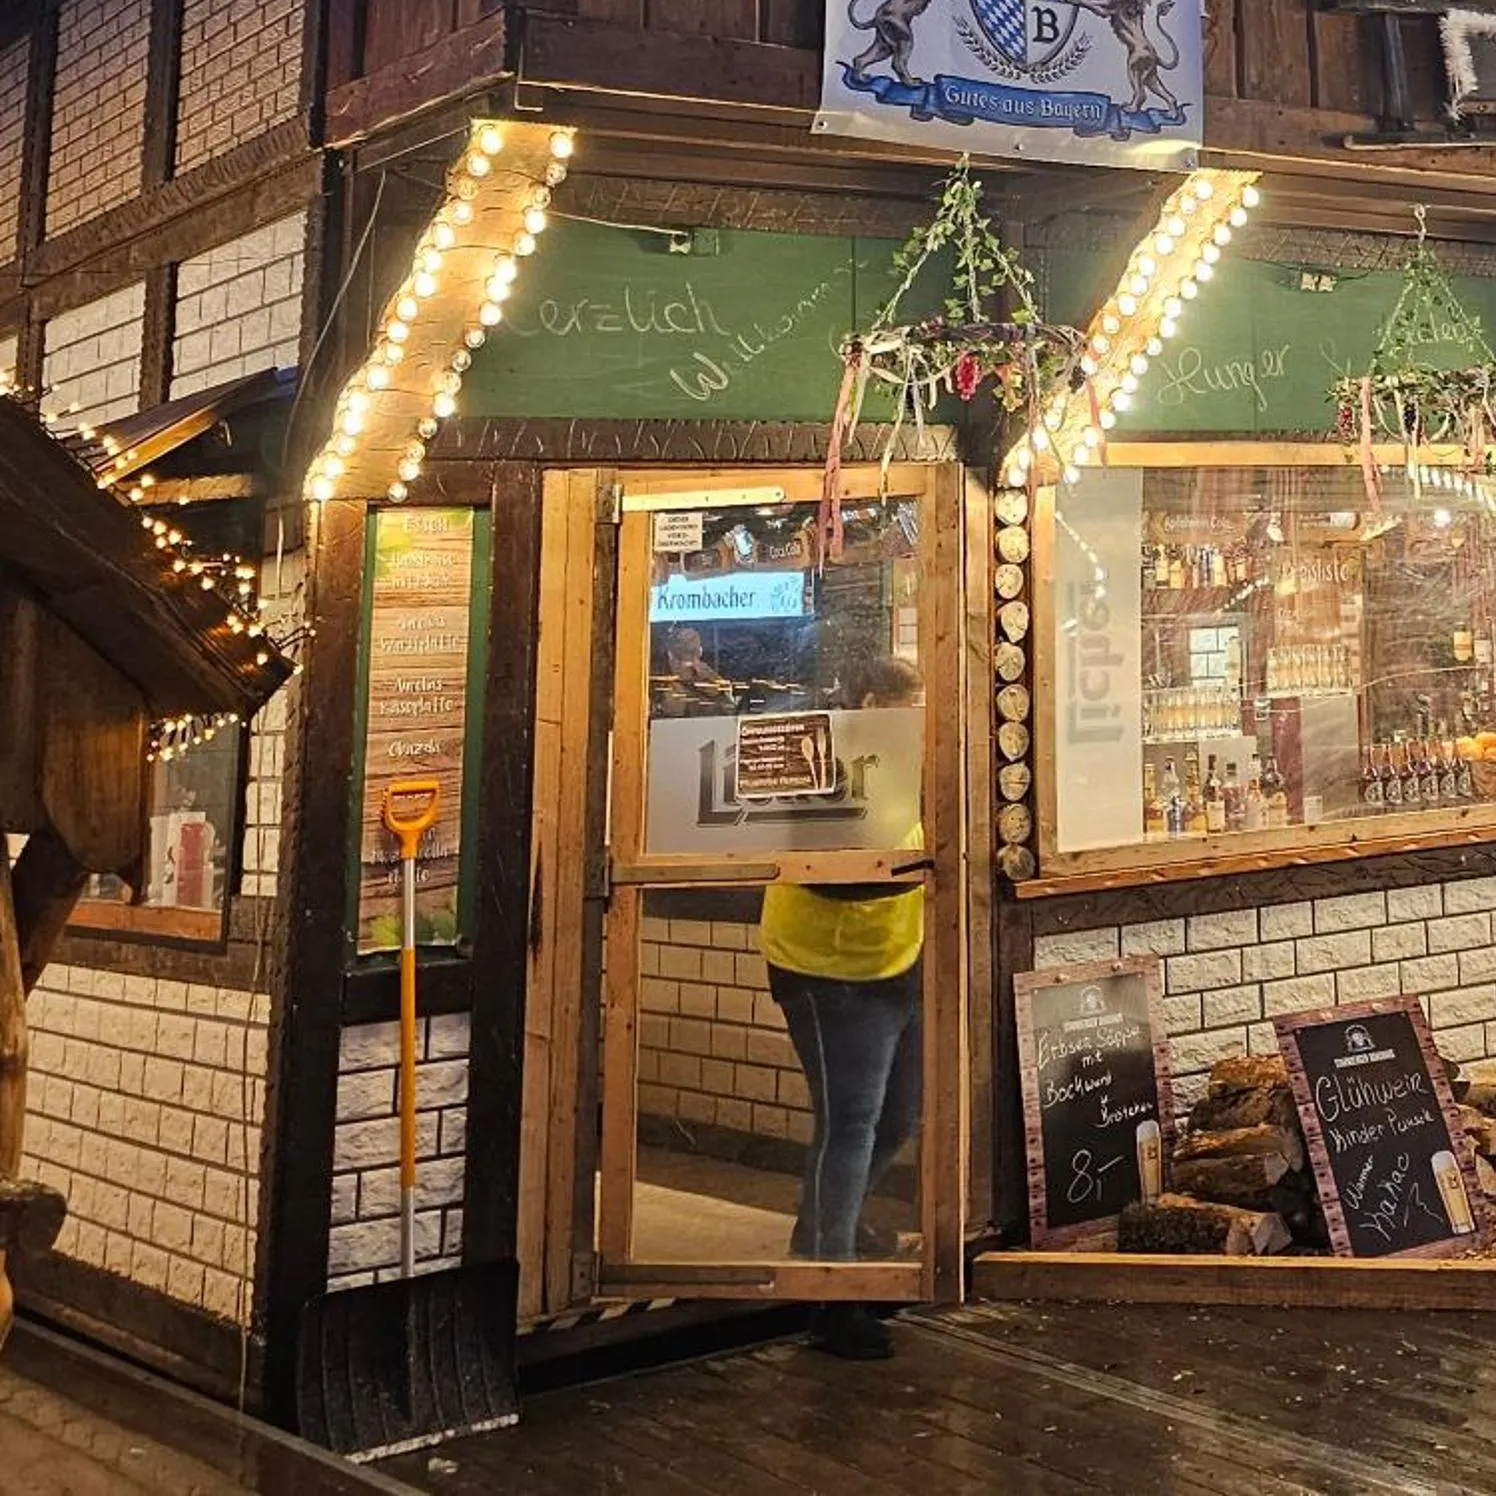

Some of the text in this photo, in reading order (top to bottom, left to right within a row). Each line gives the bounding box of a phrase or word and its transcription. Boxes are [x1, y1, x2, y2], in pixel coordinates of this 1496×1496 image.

[1032, 6, 1059, 44] B
[945, 86, 999, 112] Gutes
[1039, 97, 1101, 120] Bayern
[504, 277, 731, 338] erzlich
[1157, 343, 1290, 412] Hunger
[657, 584, 756, 611] Krombacher
[1315, 1071, 1430, 1123] Glühwein
